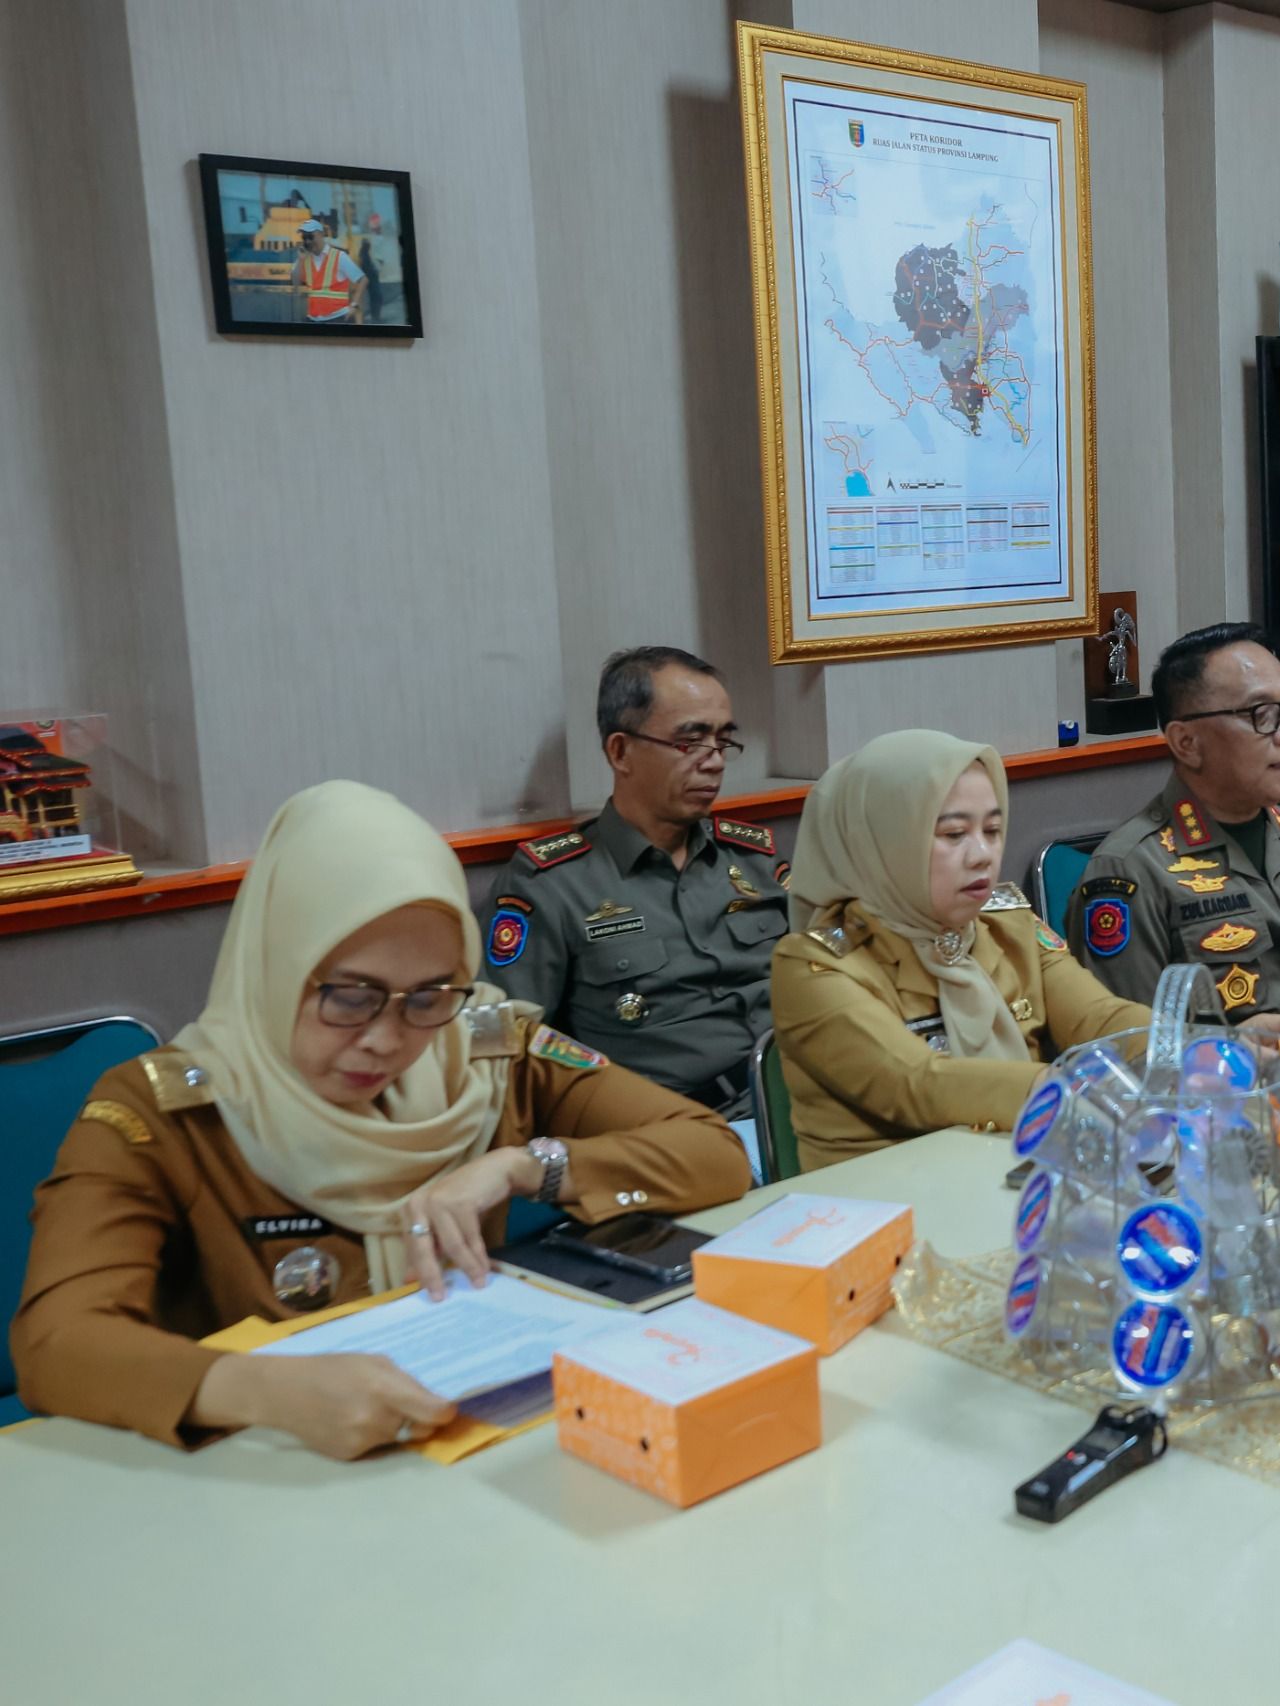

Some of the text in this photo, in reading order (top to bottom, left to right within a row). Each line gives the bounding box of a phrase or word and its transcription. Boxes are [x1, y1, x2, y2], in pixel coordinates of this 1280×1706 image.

[910, 132, 962, 147] PETA KORIDOR
[872, 138, 999, 162] RUAS JALAN STATUS PROVINSI LAMPUNG
